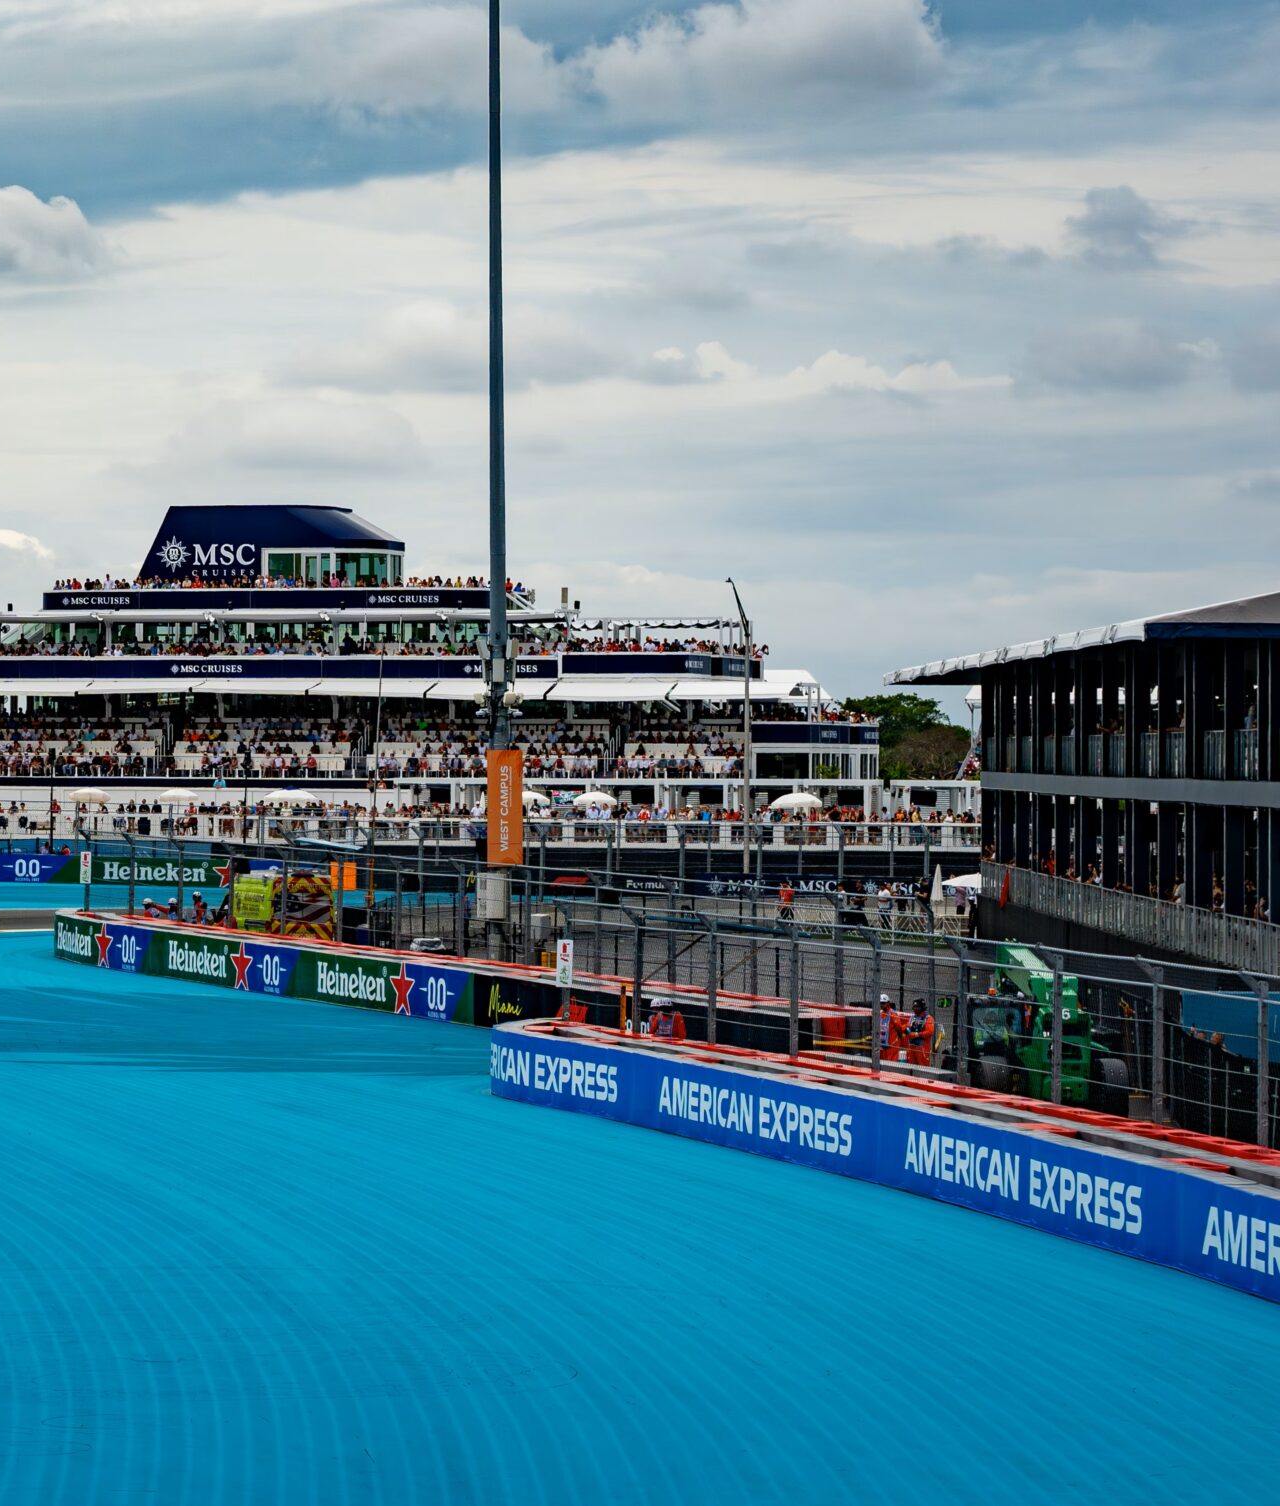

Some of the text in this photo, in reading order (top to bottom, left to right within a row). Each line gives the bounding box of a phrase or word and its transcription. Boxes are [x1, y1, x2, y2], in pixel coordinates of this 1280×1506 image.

[192, 543, 256, 566] MSC
[191, 569, 255, 577] CRUISES
[71, 596, 130, 605] MSC CRUISES
[377, 595, 440, 603] MSC CRUISES
[180, 665, 242, 674] MSC CRUISES
[500, 765, 509, 852] WEST CAMPUS
[15, 858, 40, 877] 0.0
[626, 880, 666, 890] Formu
[799, 880, 837, 892] MSC
[122, 934, 136, 964] 0.0
[263, 953, 280, 986] 0.0
[427, 976, 447, 1011] 0.0
[488, 983, 523, 1024] Miami
[534, 1053, 618, 1103] EXPRESS
[658, 1076, 852, 1157] AMERICAN EXPRESS
[904, 1128, 1143, 1235] AMERICAN EXPRESS
[1201, 1206, 1280, 1276] AMER
